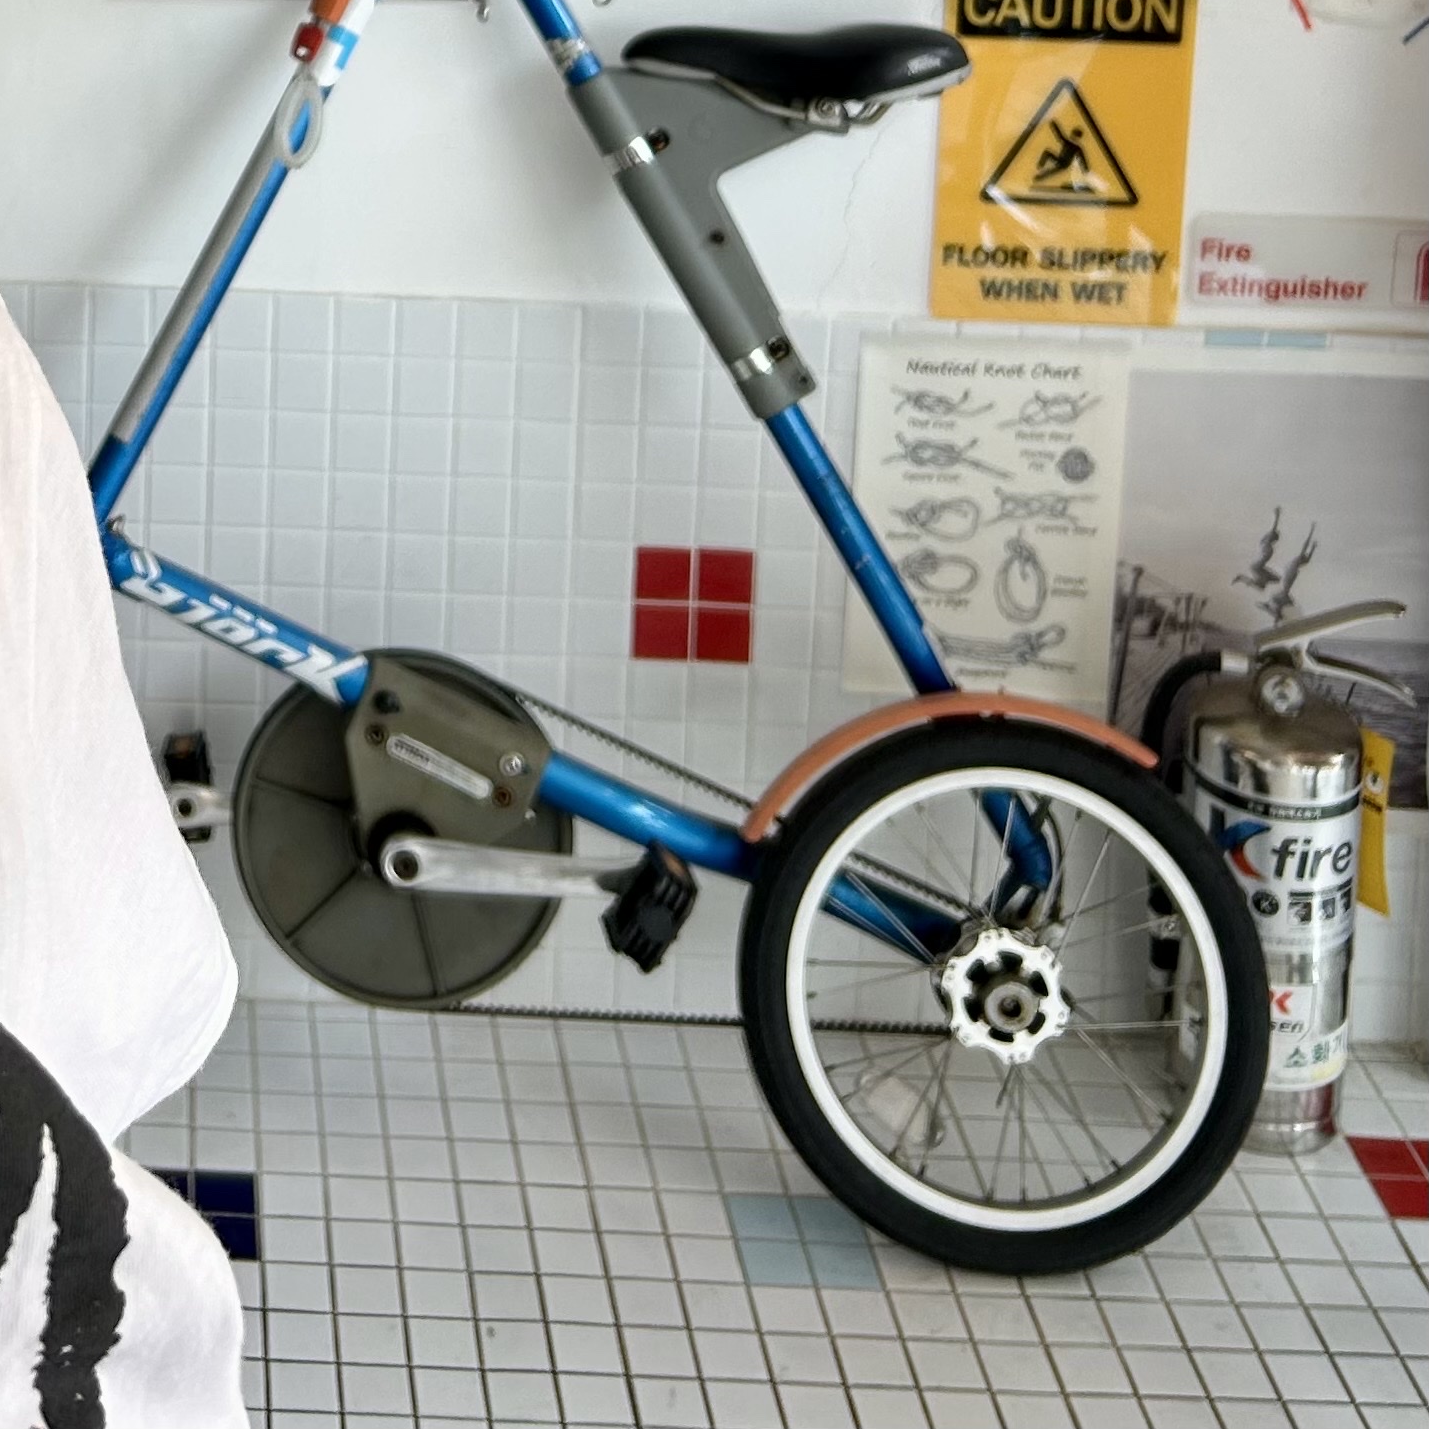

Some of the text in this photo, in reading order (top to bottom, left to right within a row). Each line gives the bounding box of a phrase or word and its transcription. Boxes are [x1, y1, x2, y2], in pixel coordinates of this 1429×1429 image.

[942, 242, 1167, 275] FLOOR SLIPPERY
[1200, 236, 1252, 262] Fire
[979, 276, 1128, 306] WHEN WET
[1198, 270, 1369, 302] Extinguisher
[906, 358, 1084, 381] Nautical Knot Chart
[1270, 835, 1355, 881] fire
